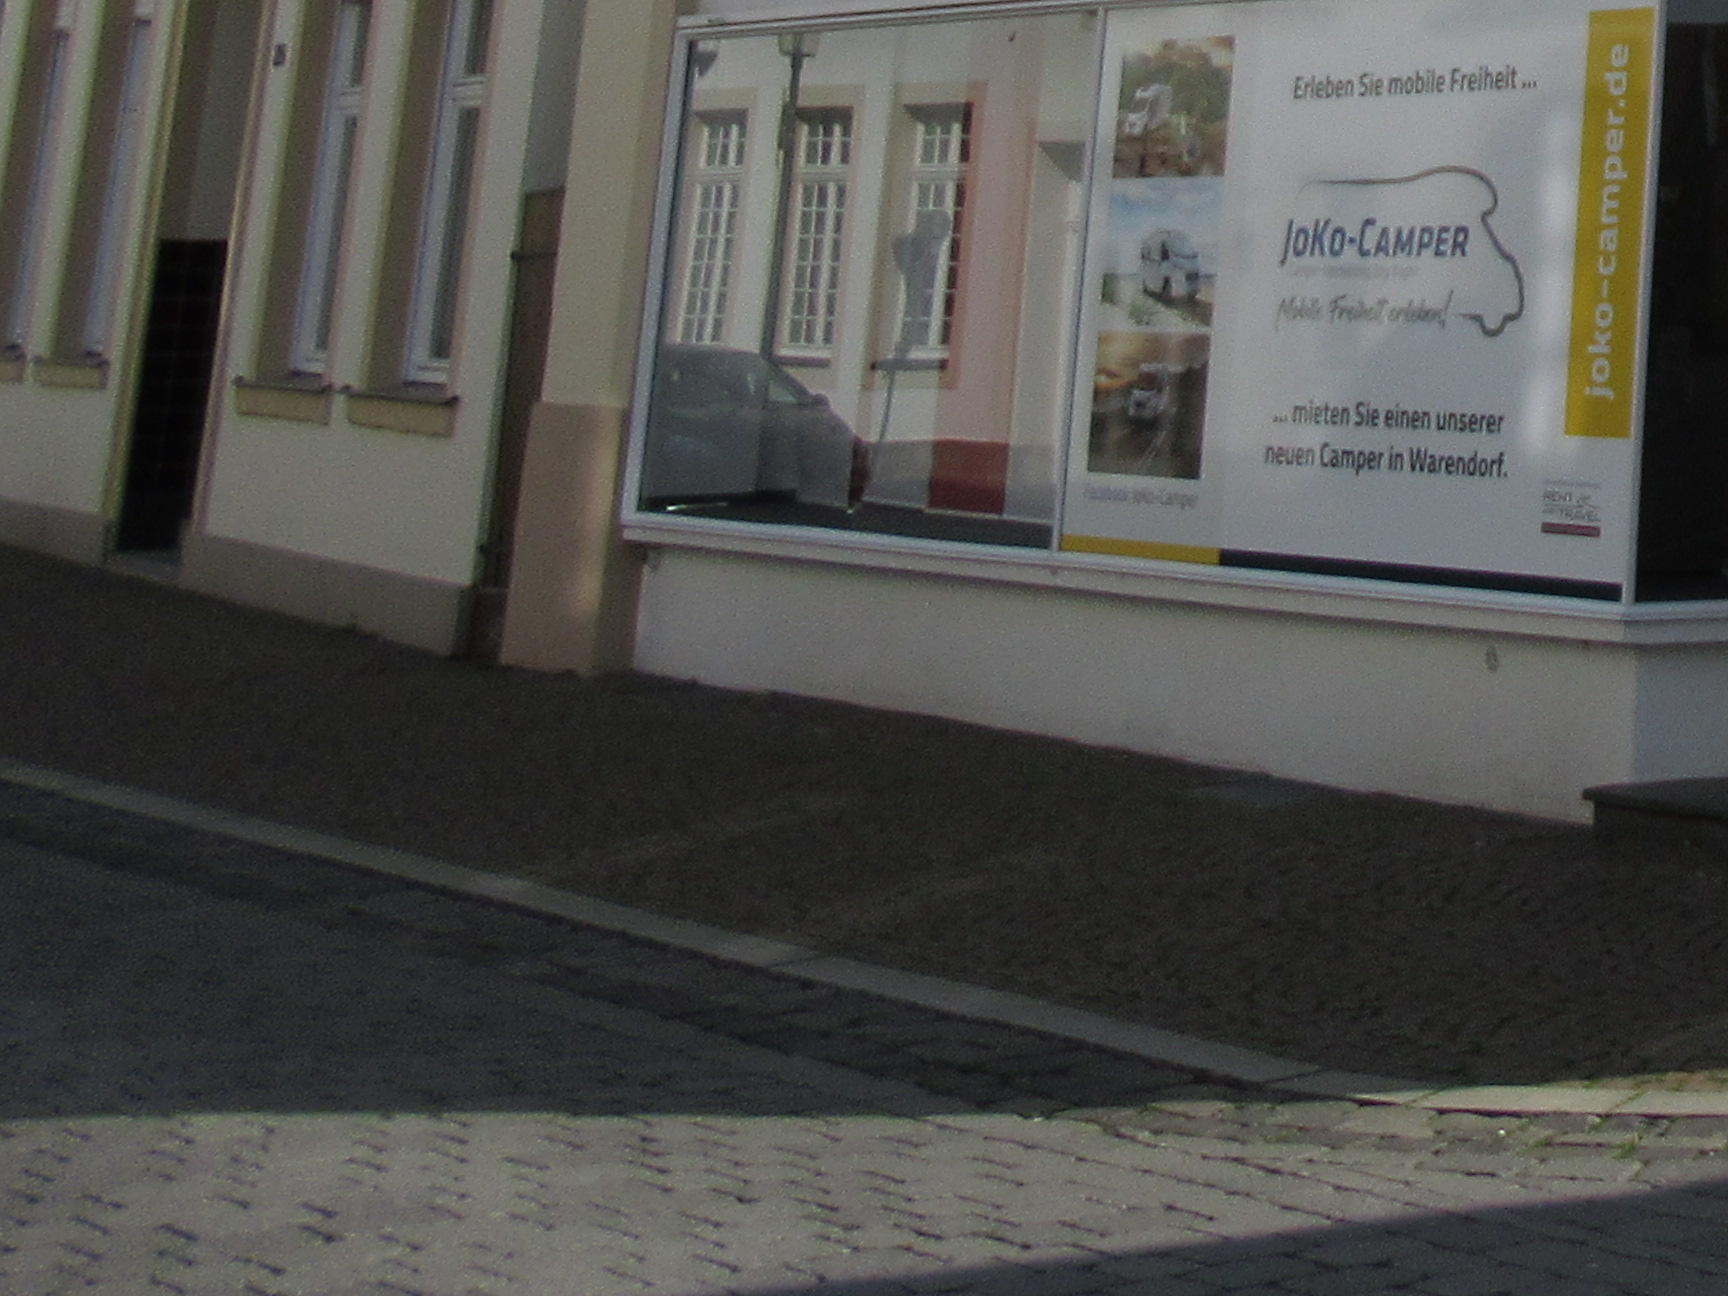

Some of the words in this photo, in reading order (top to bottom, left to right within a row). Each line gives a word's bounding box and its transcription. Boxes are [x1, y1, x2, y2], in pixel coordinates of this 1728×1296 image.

[1293, 75, 1354, 100] Erleben
[1357, 71, 1383, 97] Sie
[1387, 68, 1446, 95] mobile
[1449, 65, 1518, 92] Freiheit
[1585, 42, 1630, 401] joko-camper.de
[1291, 401, 1350, 425] mieten
[1354, 401, 1379, 427] Sie
[1384, 403, 1431, 431] einen
[1436, 411, 1504, 434] unserer
[1264, 444, 1315, 466] neuen
[1319, 442, 1384, 475] Camper
[1388, 445, 1403, 471] in
[1409, 446, 1509, 478] Warendorf.
